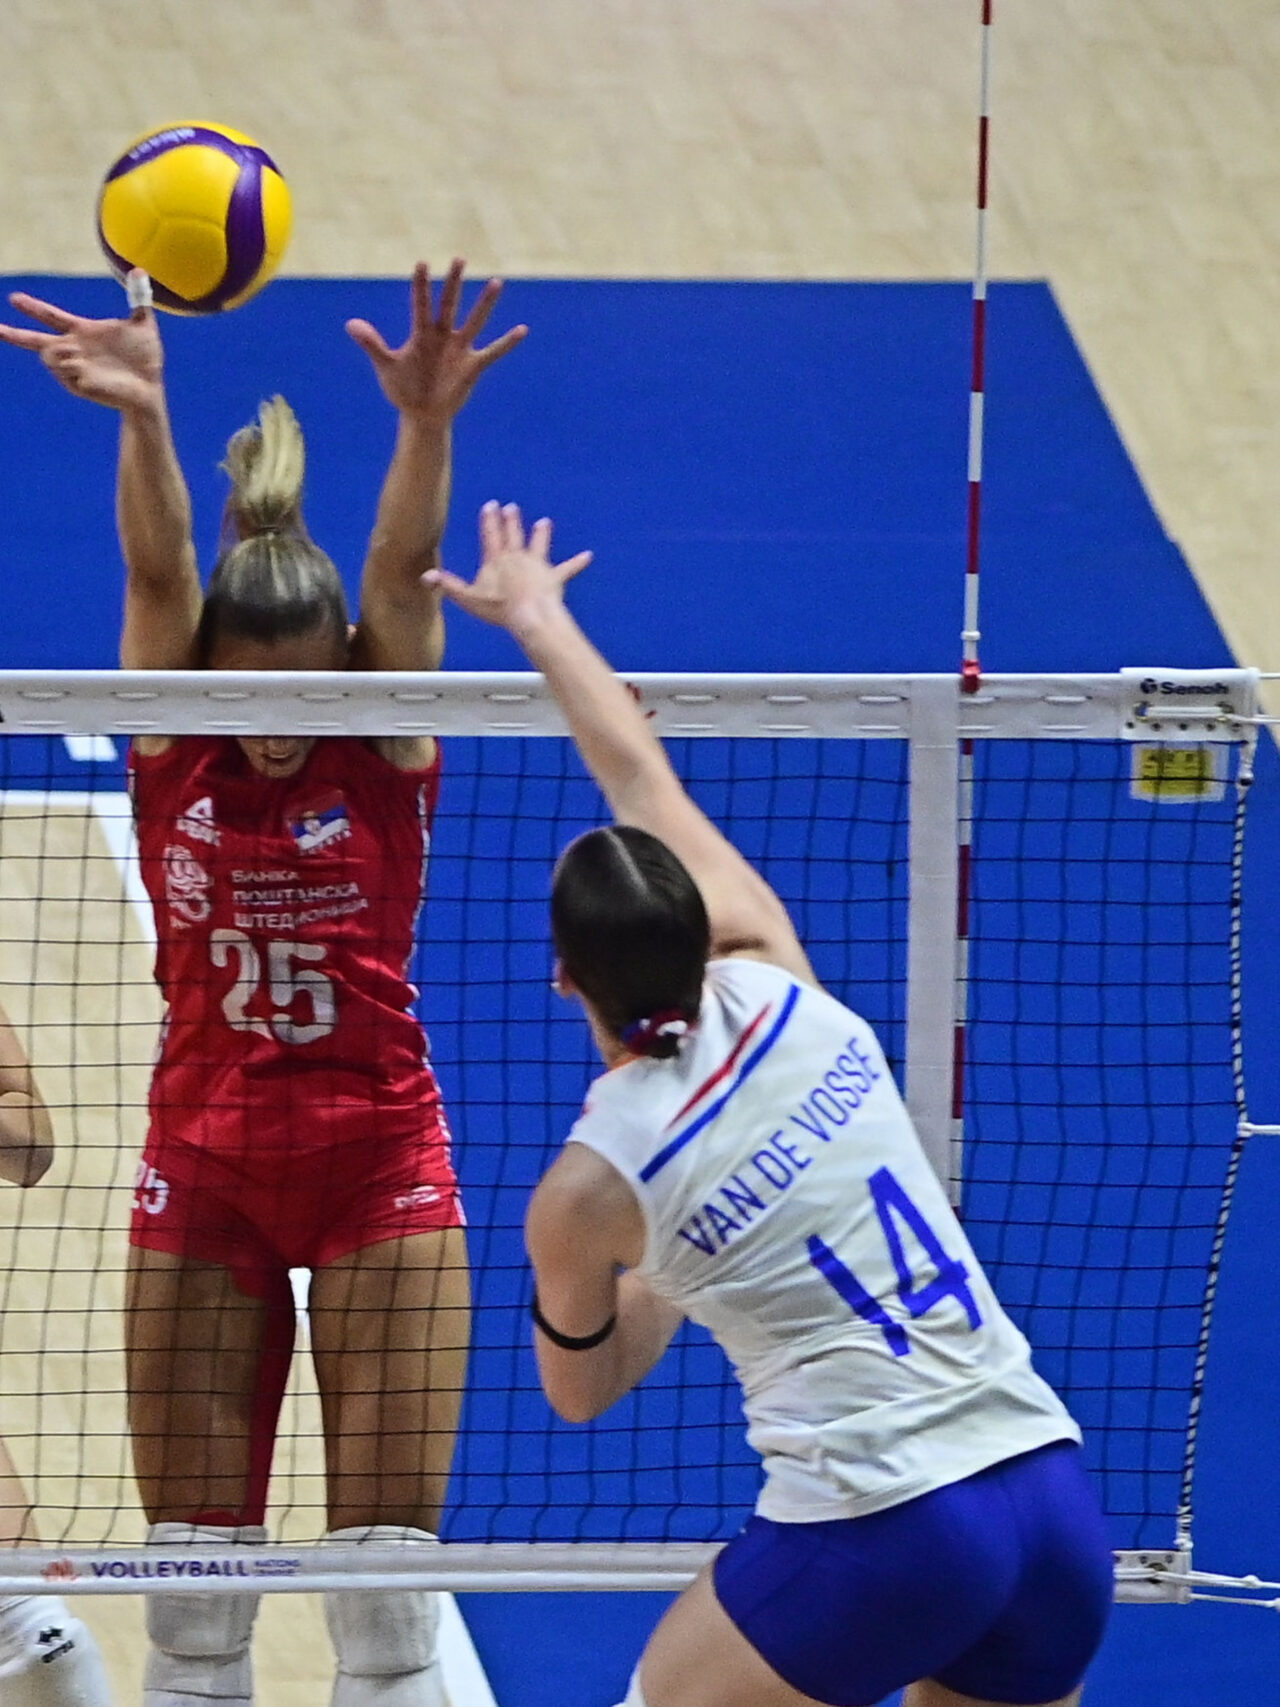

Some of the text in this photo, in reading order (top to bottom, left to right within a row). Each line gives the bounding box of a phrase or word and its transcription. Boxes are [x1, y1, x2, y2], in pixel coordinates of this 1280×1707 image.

[1160, 681, 1229, 695] Senoh
[231, 869, 300, 883] БАНКА
[210, 928, 335, 1044] 25
[677, 1037, 881, 1256] VAN DE VOSSE
[806, 1165, 984, 1357] 14
[91, 1560, 249, 1578] VOLLEYBALL
